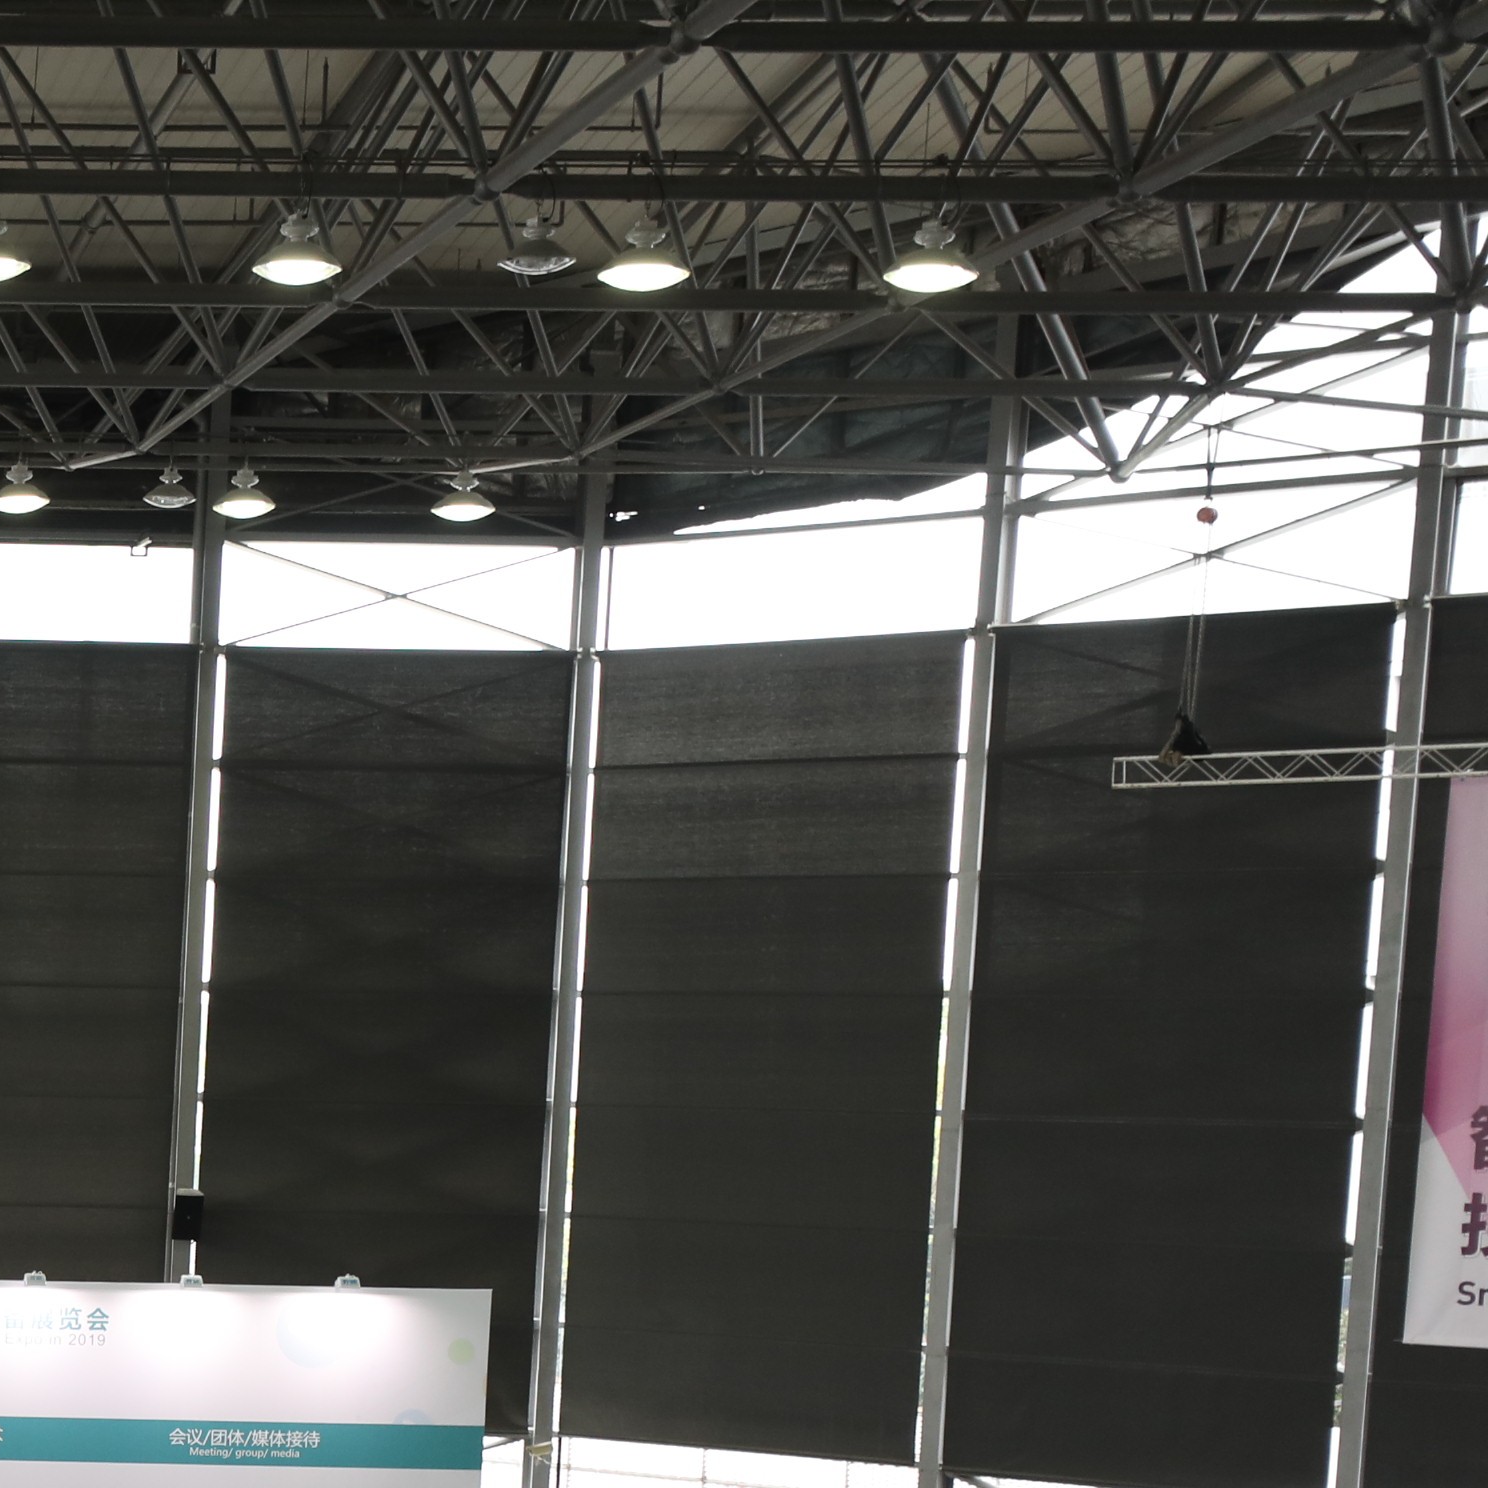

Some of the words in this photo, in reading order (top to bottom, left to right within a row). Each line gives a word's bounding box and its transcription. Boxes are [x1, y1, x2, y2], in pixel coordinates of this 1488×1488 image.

[68, 1333, 106, 1346] 2019
[169, 1428, 321, 1448] 会议/团体/媒体接待
[189, 1446, 233, 1459] Meeting/
[235, 1448, 268, 1460] group/
[270, 1447, 300, 1459] media
